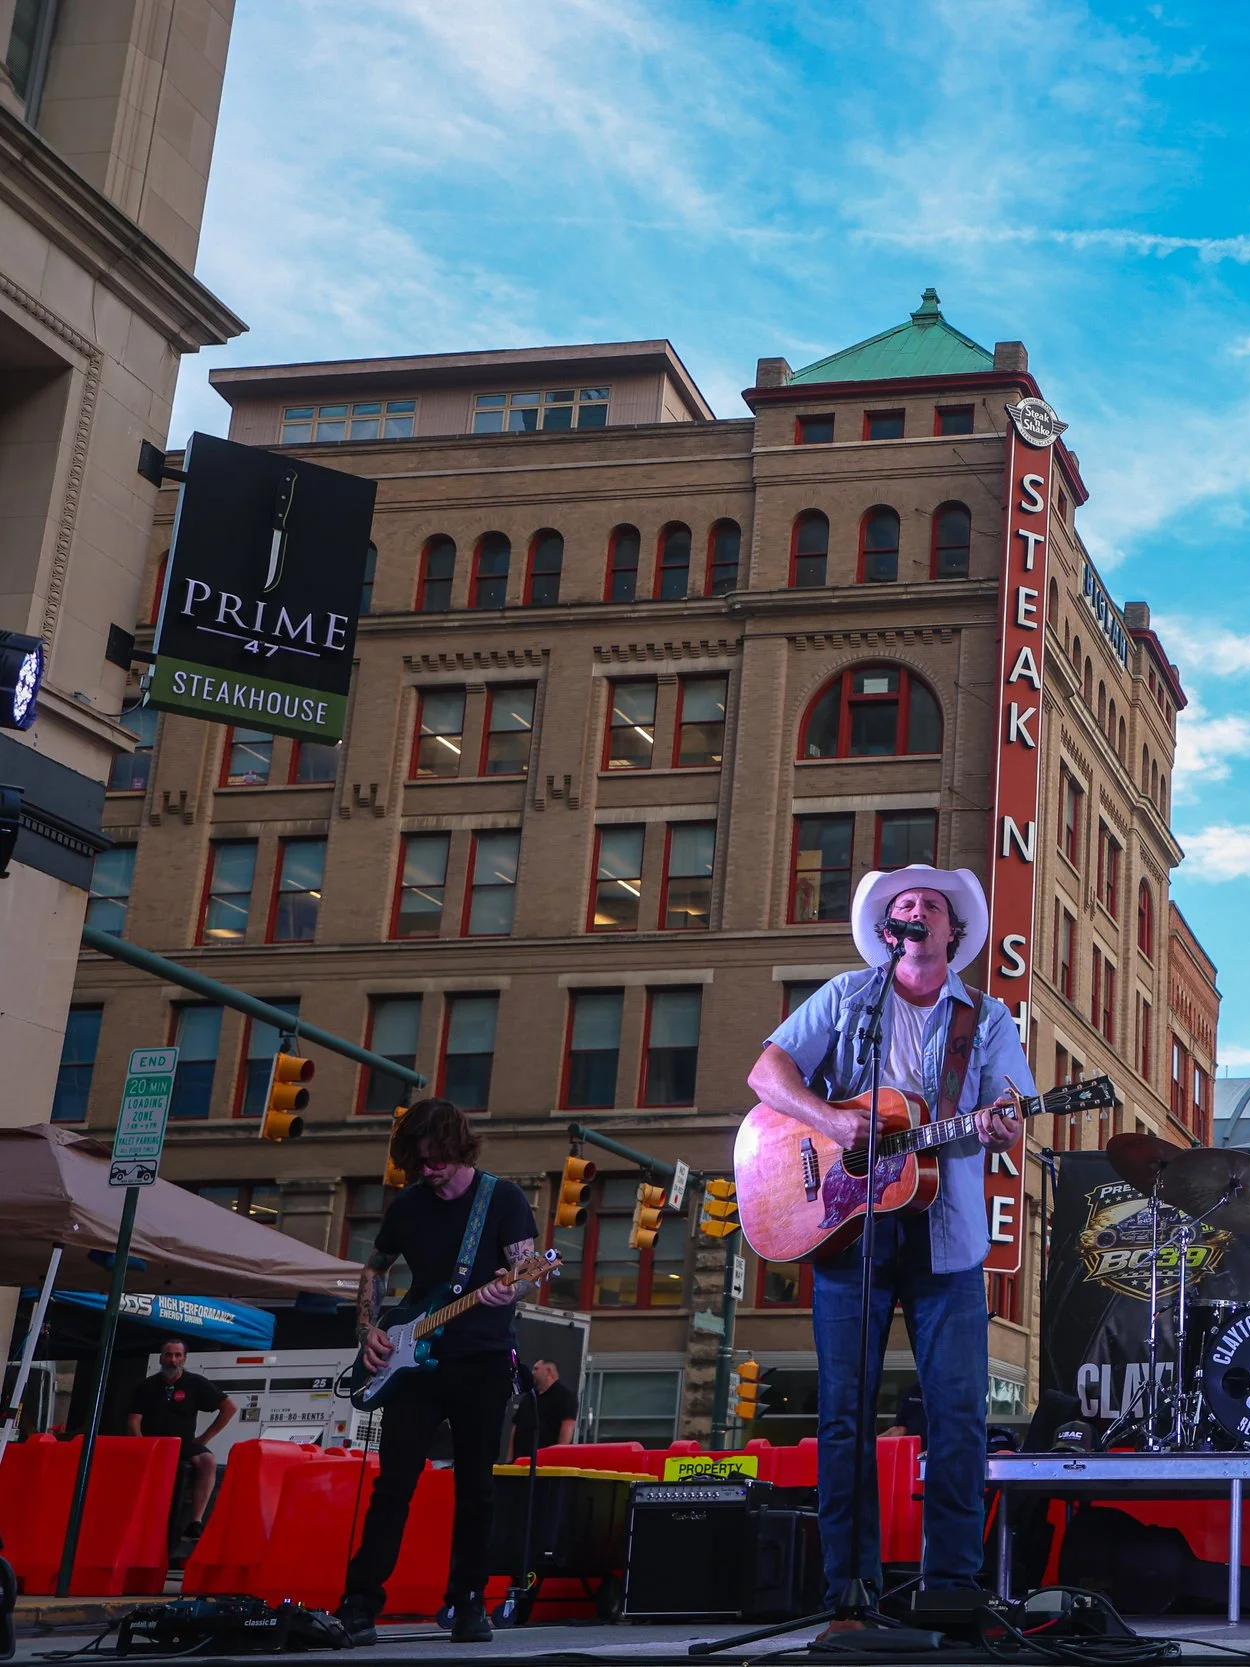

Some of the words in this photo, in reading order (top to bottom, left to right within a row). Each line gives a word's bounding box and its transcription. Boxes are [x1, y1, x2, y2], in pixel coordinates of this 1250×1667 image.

[1025, 405, 1049, 423] Steak
[1023, 418, 1051, 436] Shake
[180, 578, 348, 651] PRIME
[1009, 473, 1045, 749] STEAK
[243, 639, 279, 658] 47
[172, 671, 328, 725] STEAKHOUSE
[1001, 816, 1036, 863] N
[139, 1056, 166, 1067] END
[130, 1079, 147, 1094] 20
[149, 1083, 168, 1092] MIN
[127, 1098, 163, 1109] LOADING
[132, 1111, 154, 1122] ZONE
[136, 1136, 160, 1145] PARKING
[1093, 1247, 1208, 1276] BC39
[159, 1295, 178, 1312] HIGH
[179, 1300, 237, 1324] PERFORMANCE
[160, 1309, 183, 1322] ENERGY
[185, 1314, 203, 1325] DRINK
[312, 1379, 327, 1388] 25
[1058, 1431, 1083, 1439] USAC
[679, 1464, 743, 1474] PROPERTY
